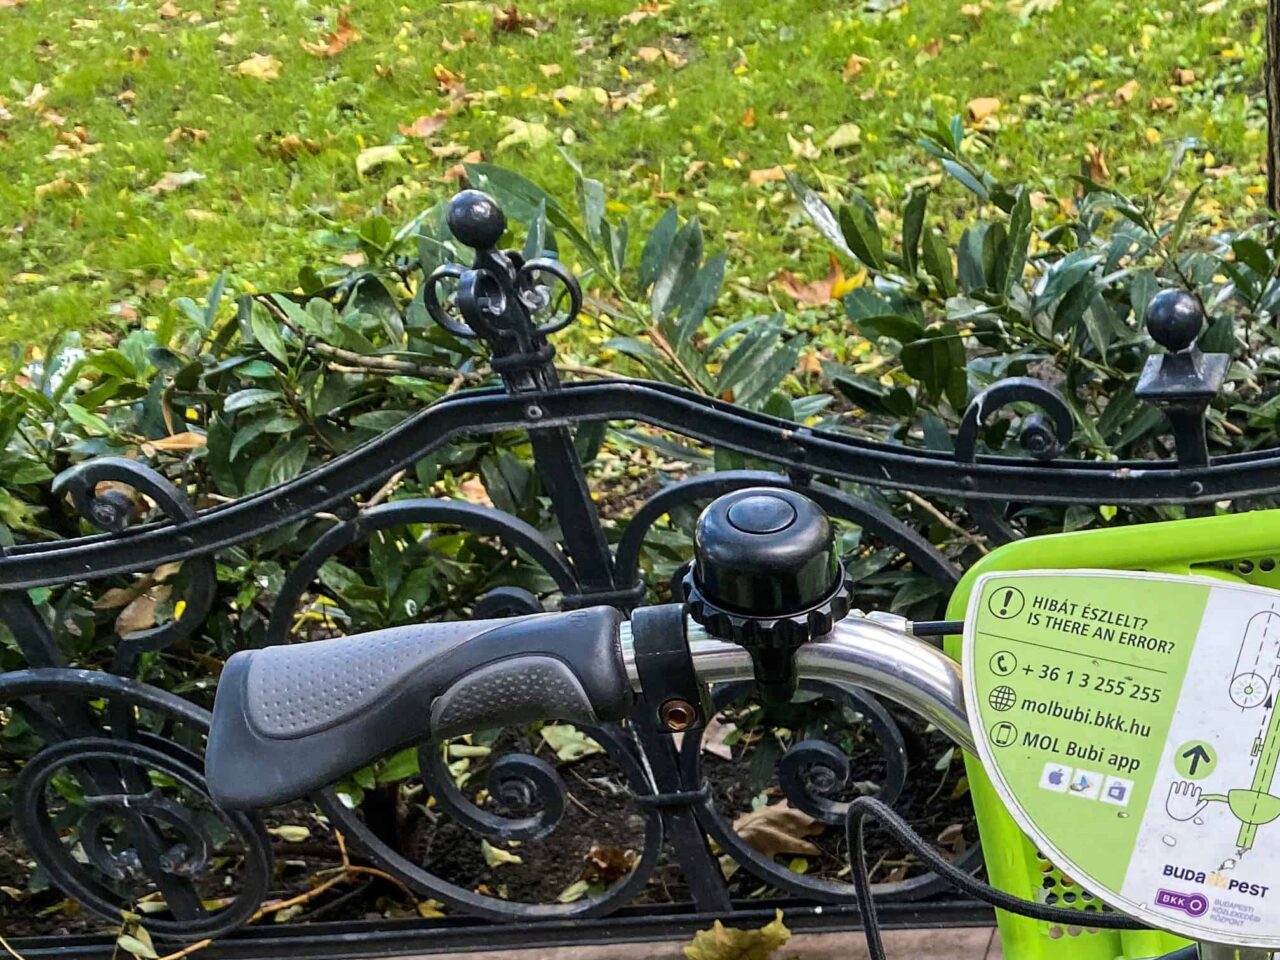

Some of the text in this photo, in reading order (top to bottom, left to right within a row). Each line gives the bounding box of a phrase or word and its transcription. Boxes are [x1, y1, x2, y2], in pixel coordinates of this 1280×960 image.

[1032, 596, 1148, 630] HIBÁT ÉSZLELT?
[1027, 612, 1176, 654] IS THERE AN ERROR?
[1038, 664, 1060, 682] 36
[1066, 670, 1074, 684] 1
[1078, 674, 1090, 688] 3
[1094, 676, 1126, 696] 255
[1129, 684, 1162, 704] 255
[1021, 699, 1151, 738] molbubi.bkk.hu
[1022, 732, 1140, 774] MOL Bubi app
[1162, 894, 1186, 907] BKK
